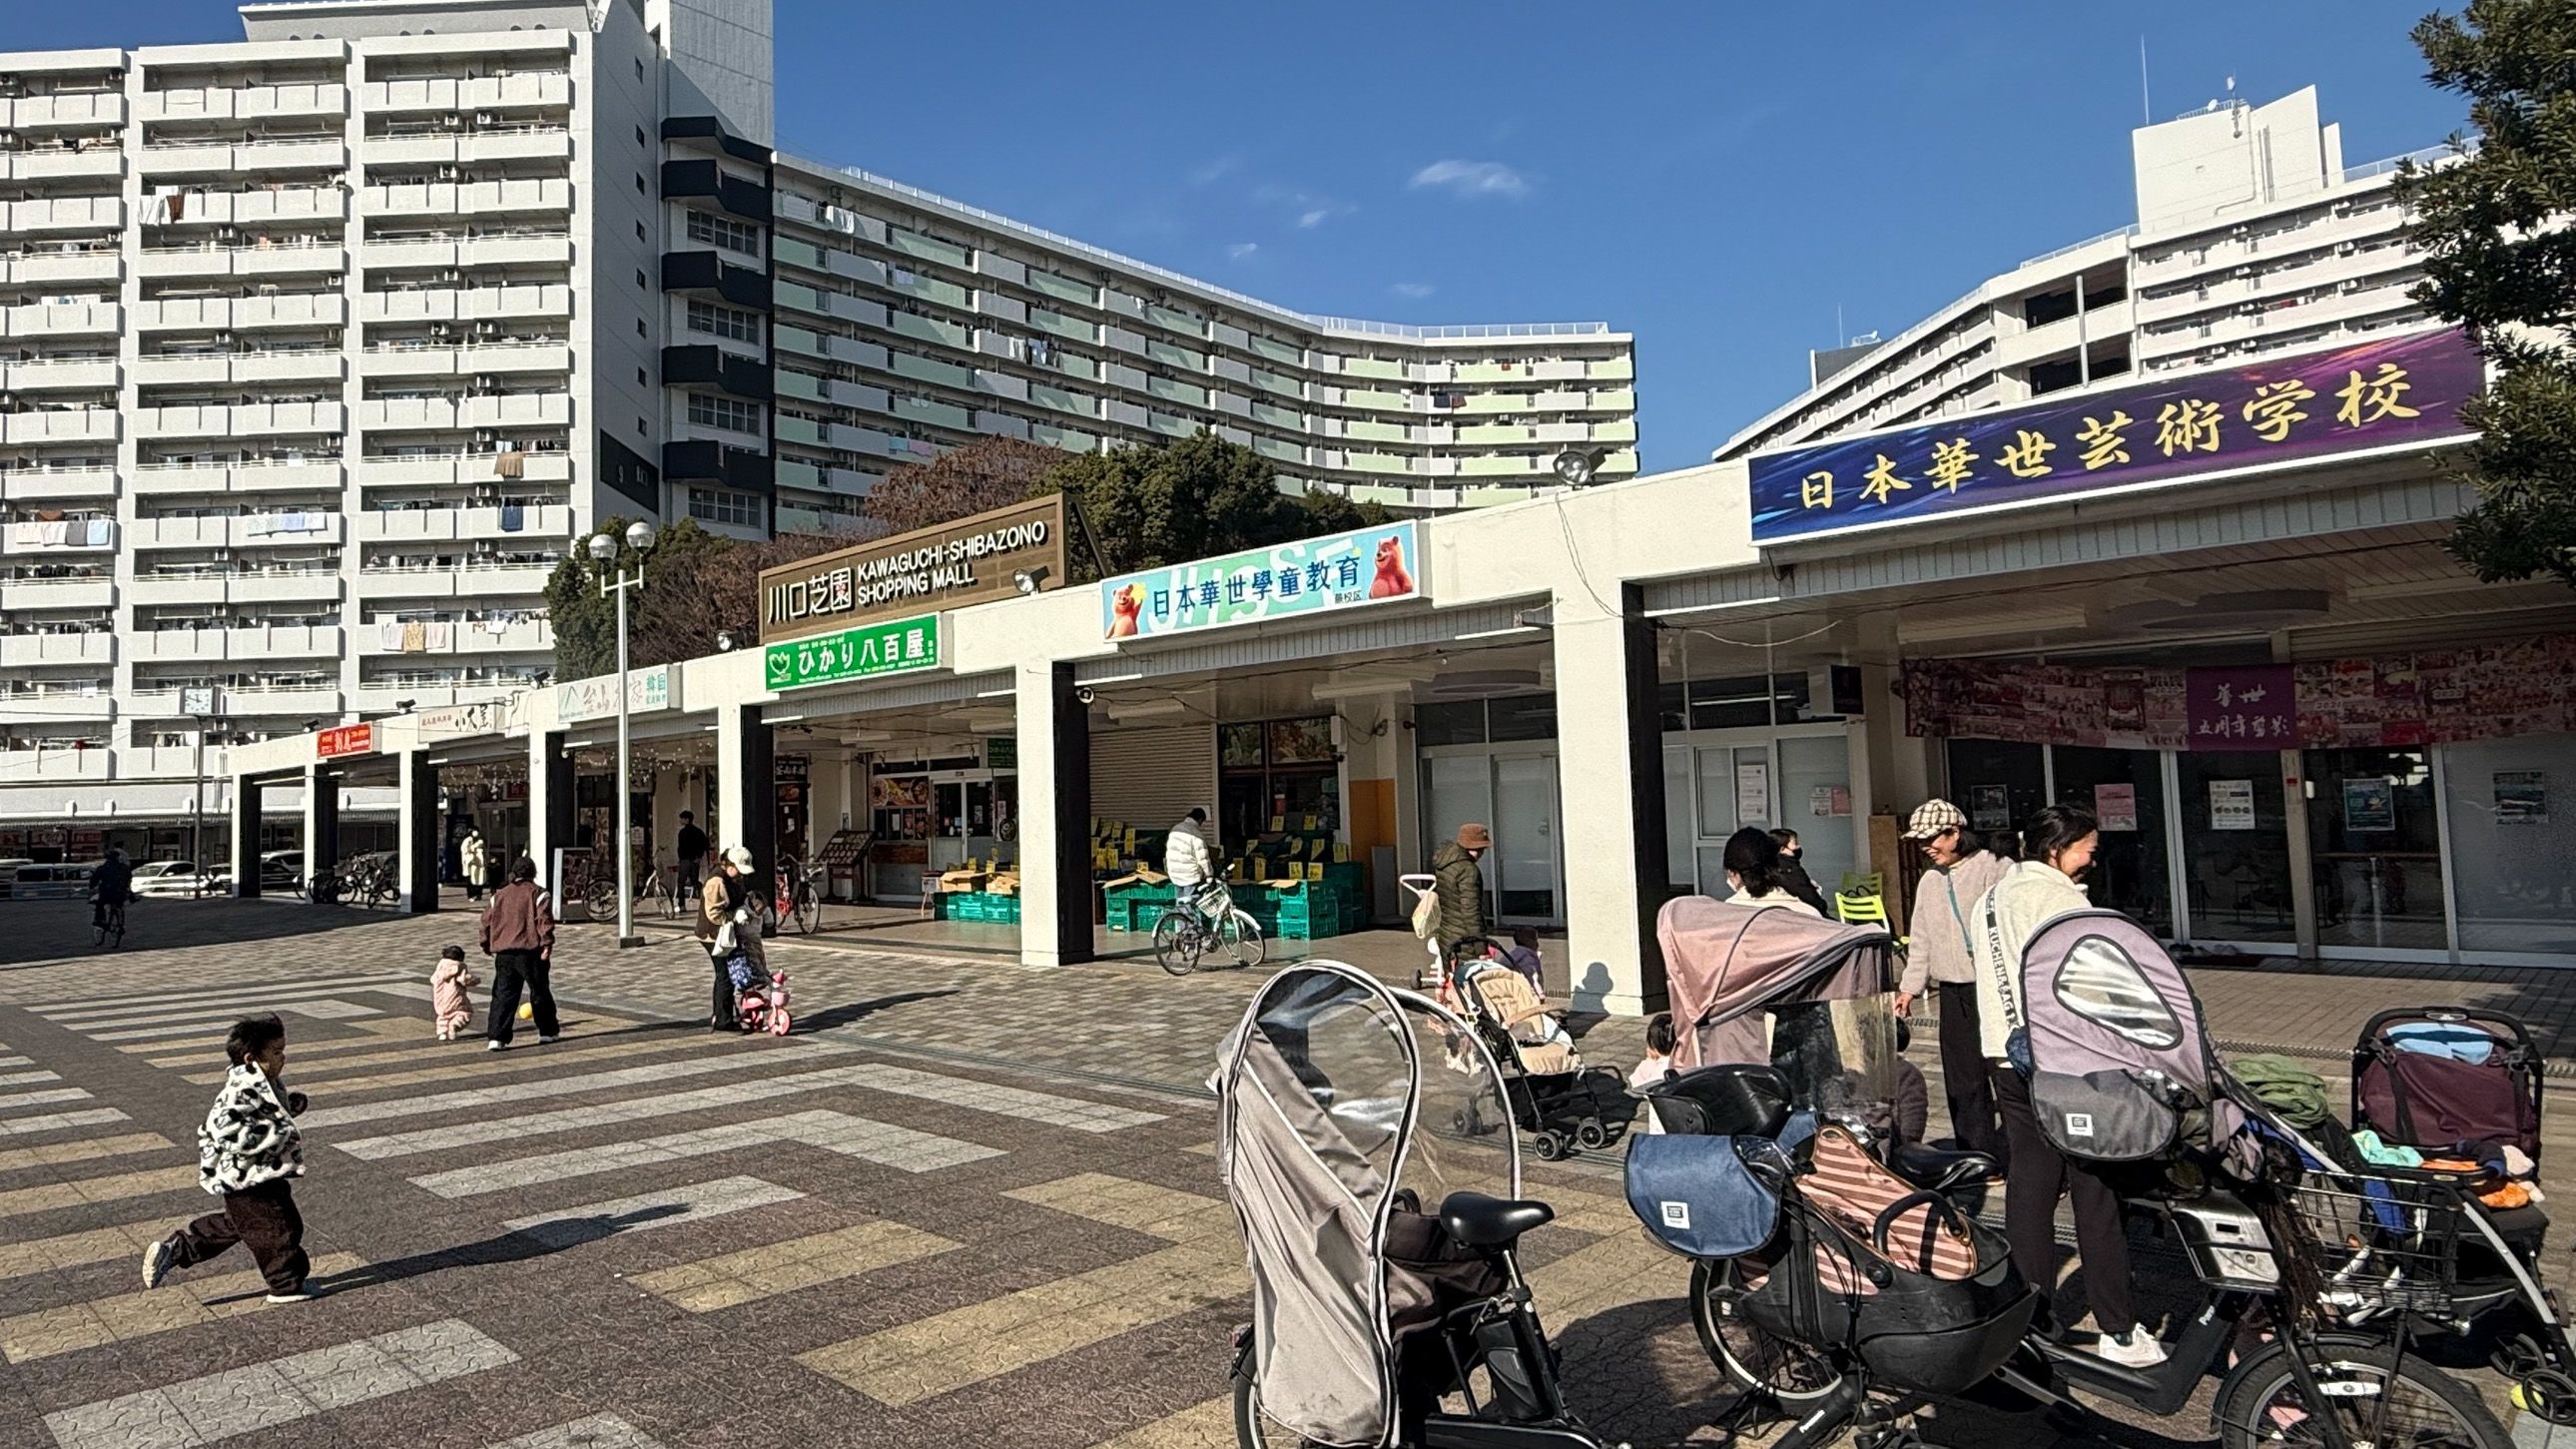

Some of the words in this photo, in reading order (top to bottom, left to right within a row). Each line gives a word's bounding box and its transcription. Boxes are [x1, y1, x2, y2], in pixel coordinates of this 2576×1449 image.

[1800, 362, 2422, 509] 日本華世芸術学校
[858, 520, 1045, 582] KAWAGUCHI-SHIBAZONO
[768, 567, 852, 623] 川口芝園
[858, 572, 930, 606] SHOPPING
[933, 563, 974, 595] MALL
[1153, 554, 1361, 617] 日本華世學童教育
[798, 628, 926, 676] ひかり八百屋
[2542, 674, 2576, 687] 202
